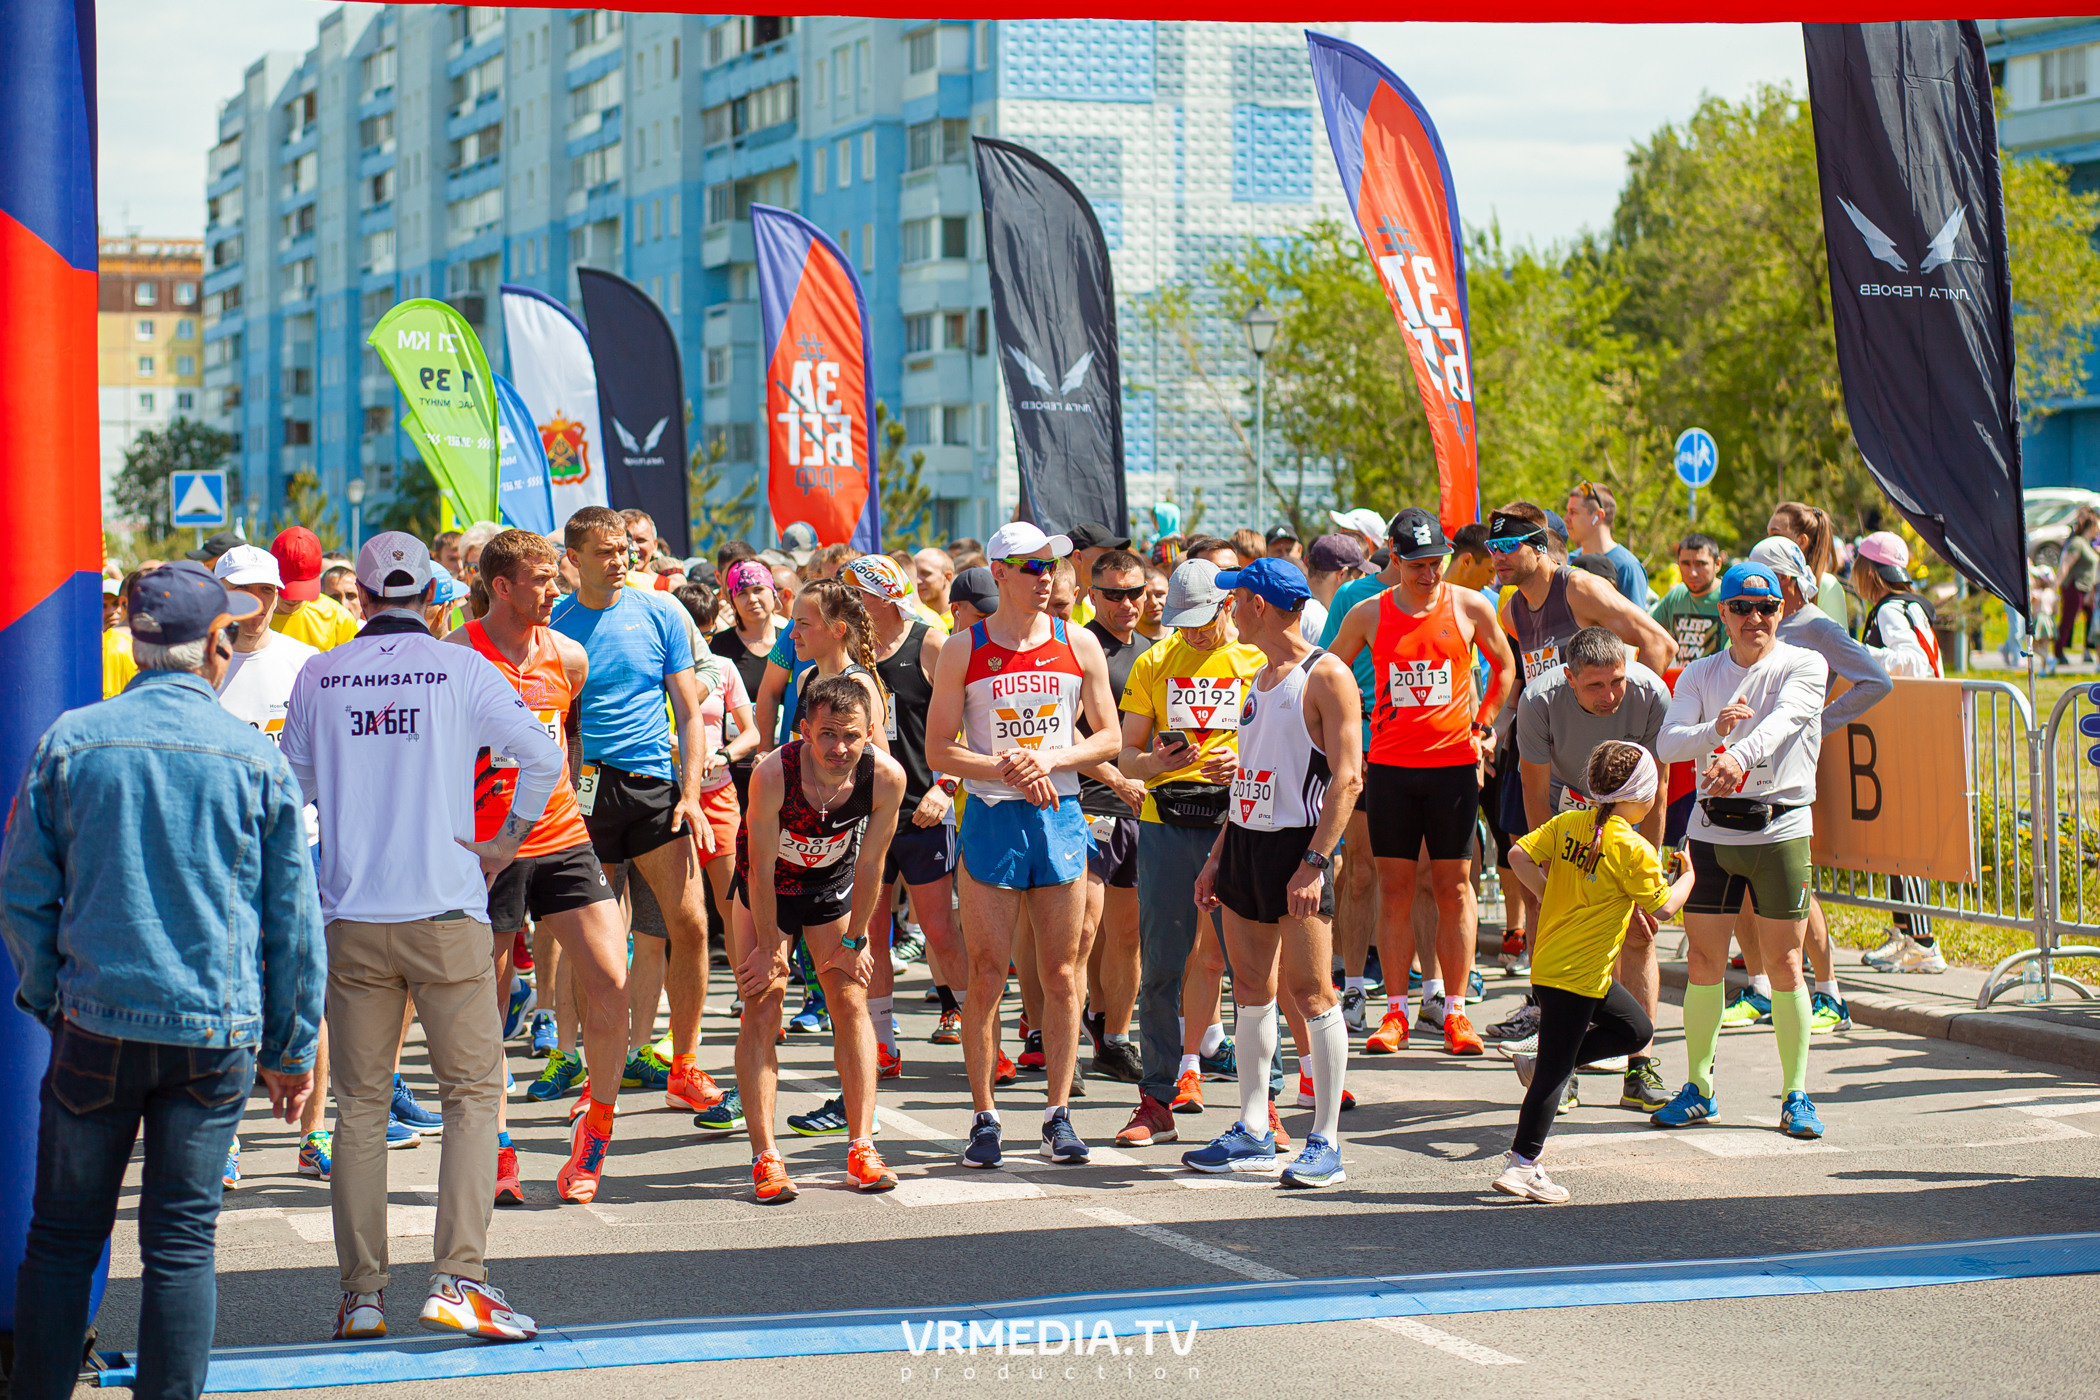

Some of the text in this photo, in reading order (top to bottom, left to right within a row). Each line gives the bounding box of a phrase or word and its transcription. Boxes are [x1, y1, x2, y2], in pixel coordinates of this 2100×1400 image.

[1676, 618, 1713, 632] SLEEP
[1678, 632, 1706, 647] LESS
[1677, 646, 1705, 658] RUN
[320, 672, 448, 689] ОРГАНИЗАТОР
[992, 674, 1060, 700] RUSSIA
[1394, 671, 1448, 687] 20113
[1171, 689, 1235, 706] 20192
[1416, 689, 1427, 698] 10
[351, 708, 421, 736] ЗАБЕГ
[1197, 709, 1209, 719] 10
[996, 717, 1060, 738] 30049
[1847, 723, 1883, 822] B
[1233, 780, 1271, 801] 20130
[1242, 804, 1250, 814] 10
[782, 838, 846, 855] 20014
